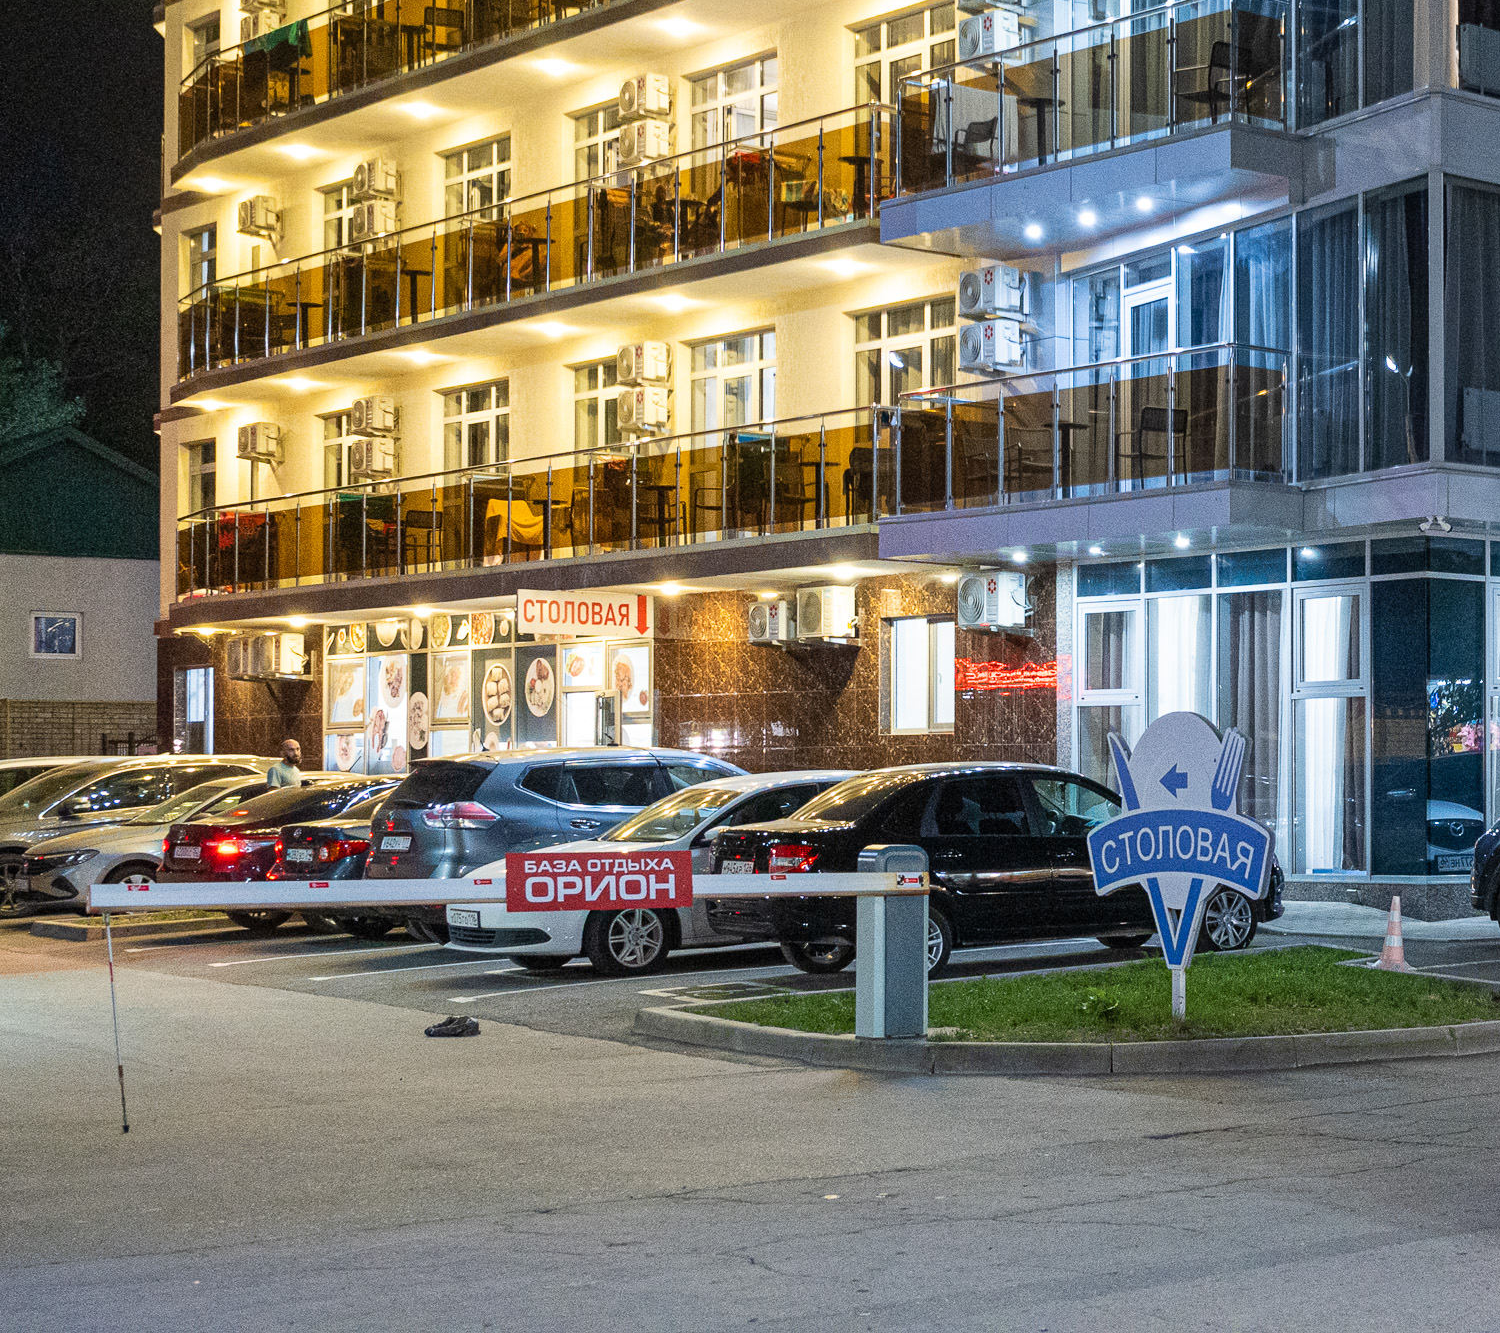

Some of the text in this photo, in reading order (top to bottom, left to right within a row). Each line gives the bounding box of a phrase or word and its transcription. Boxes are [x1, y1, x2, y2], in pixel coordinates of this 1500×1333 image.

[523, 598, 630, 627] СТОЛОВАЯ
[524, 858, 675, 874] БАЗА ОТДЫХА
[1101, 825, 1255, 880] СТОЛОВАЯ
[525, 874, 676, 903] ОРИОН
